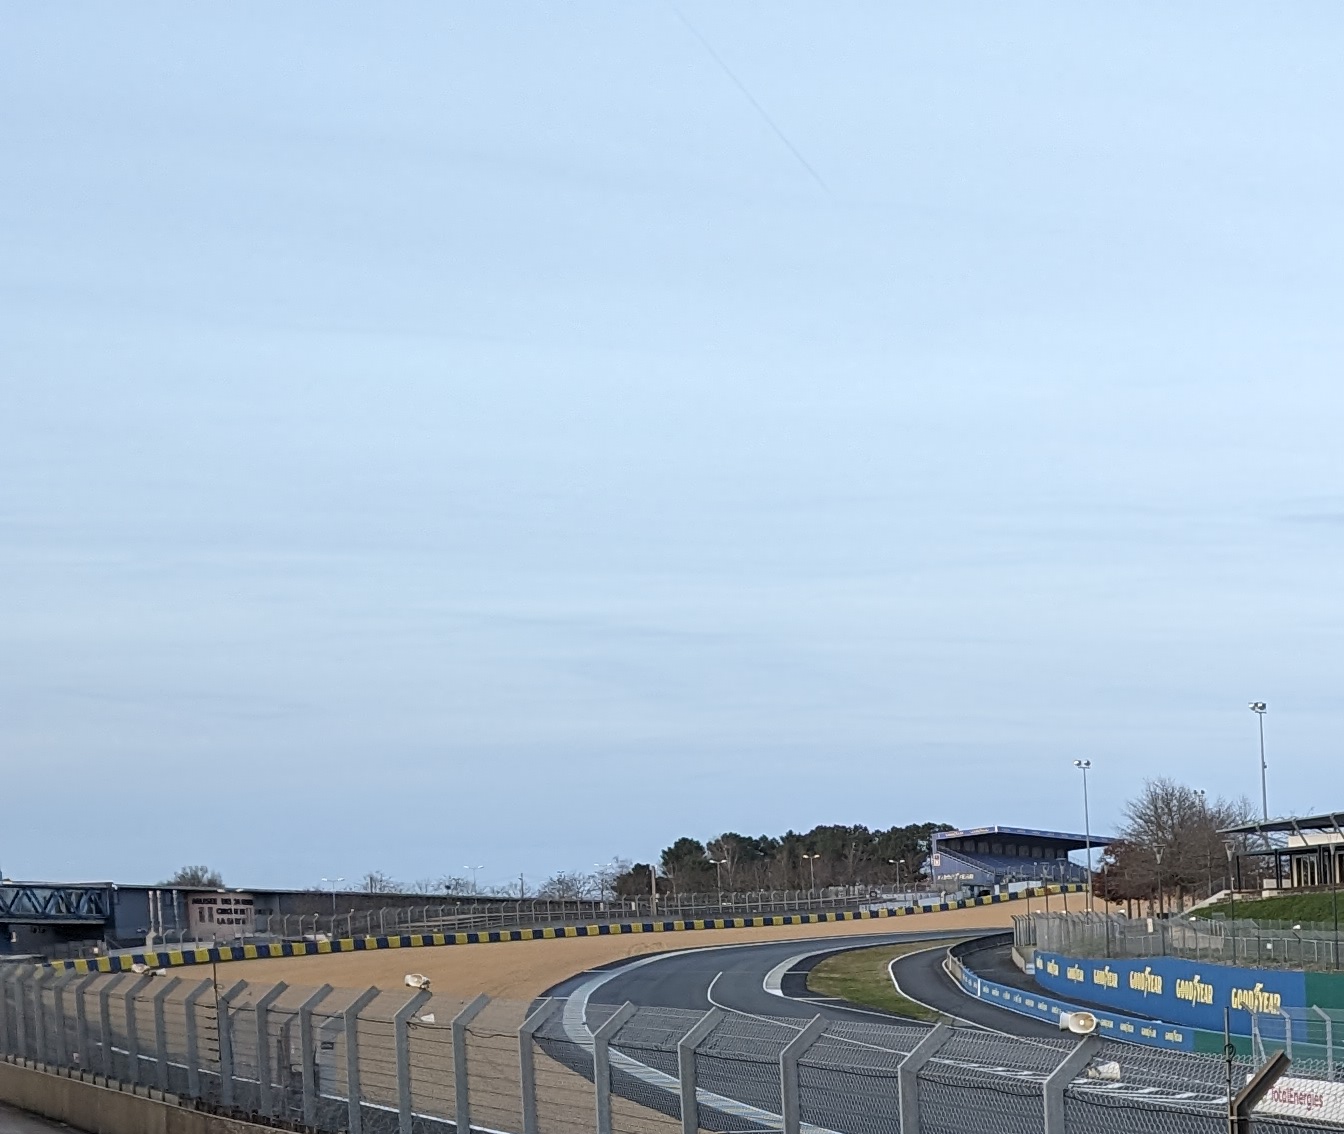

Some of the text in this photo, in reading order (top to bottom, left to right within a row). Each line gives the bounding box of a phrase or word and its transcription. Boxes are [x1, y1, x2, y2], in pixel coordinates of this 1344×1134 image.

[1129, 967, 1163, 996] GOODYEAR
[1176, 976, 1214, 1006] GOODYEAR
[1231, 983, 1281, 1015] GOODYEAR
